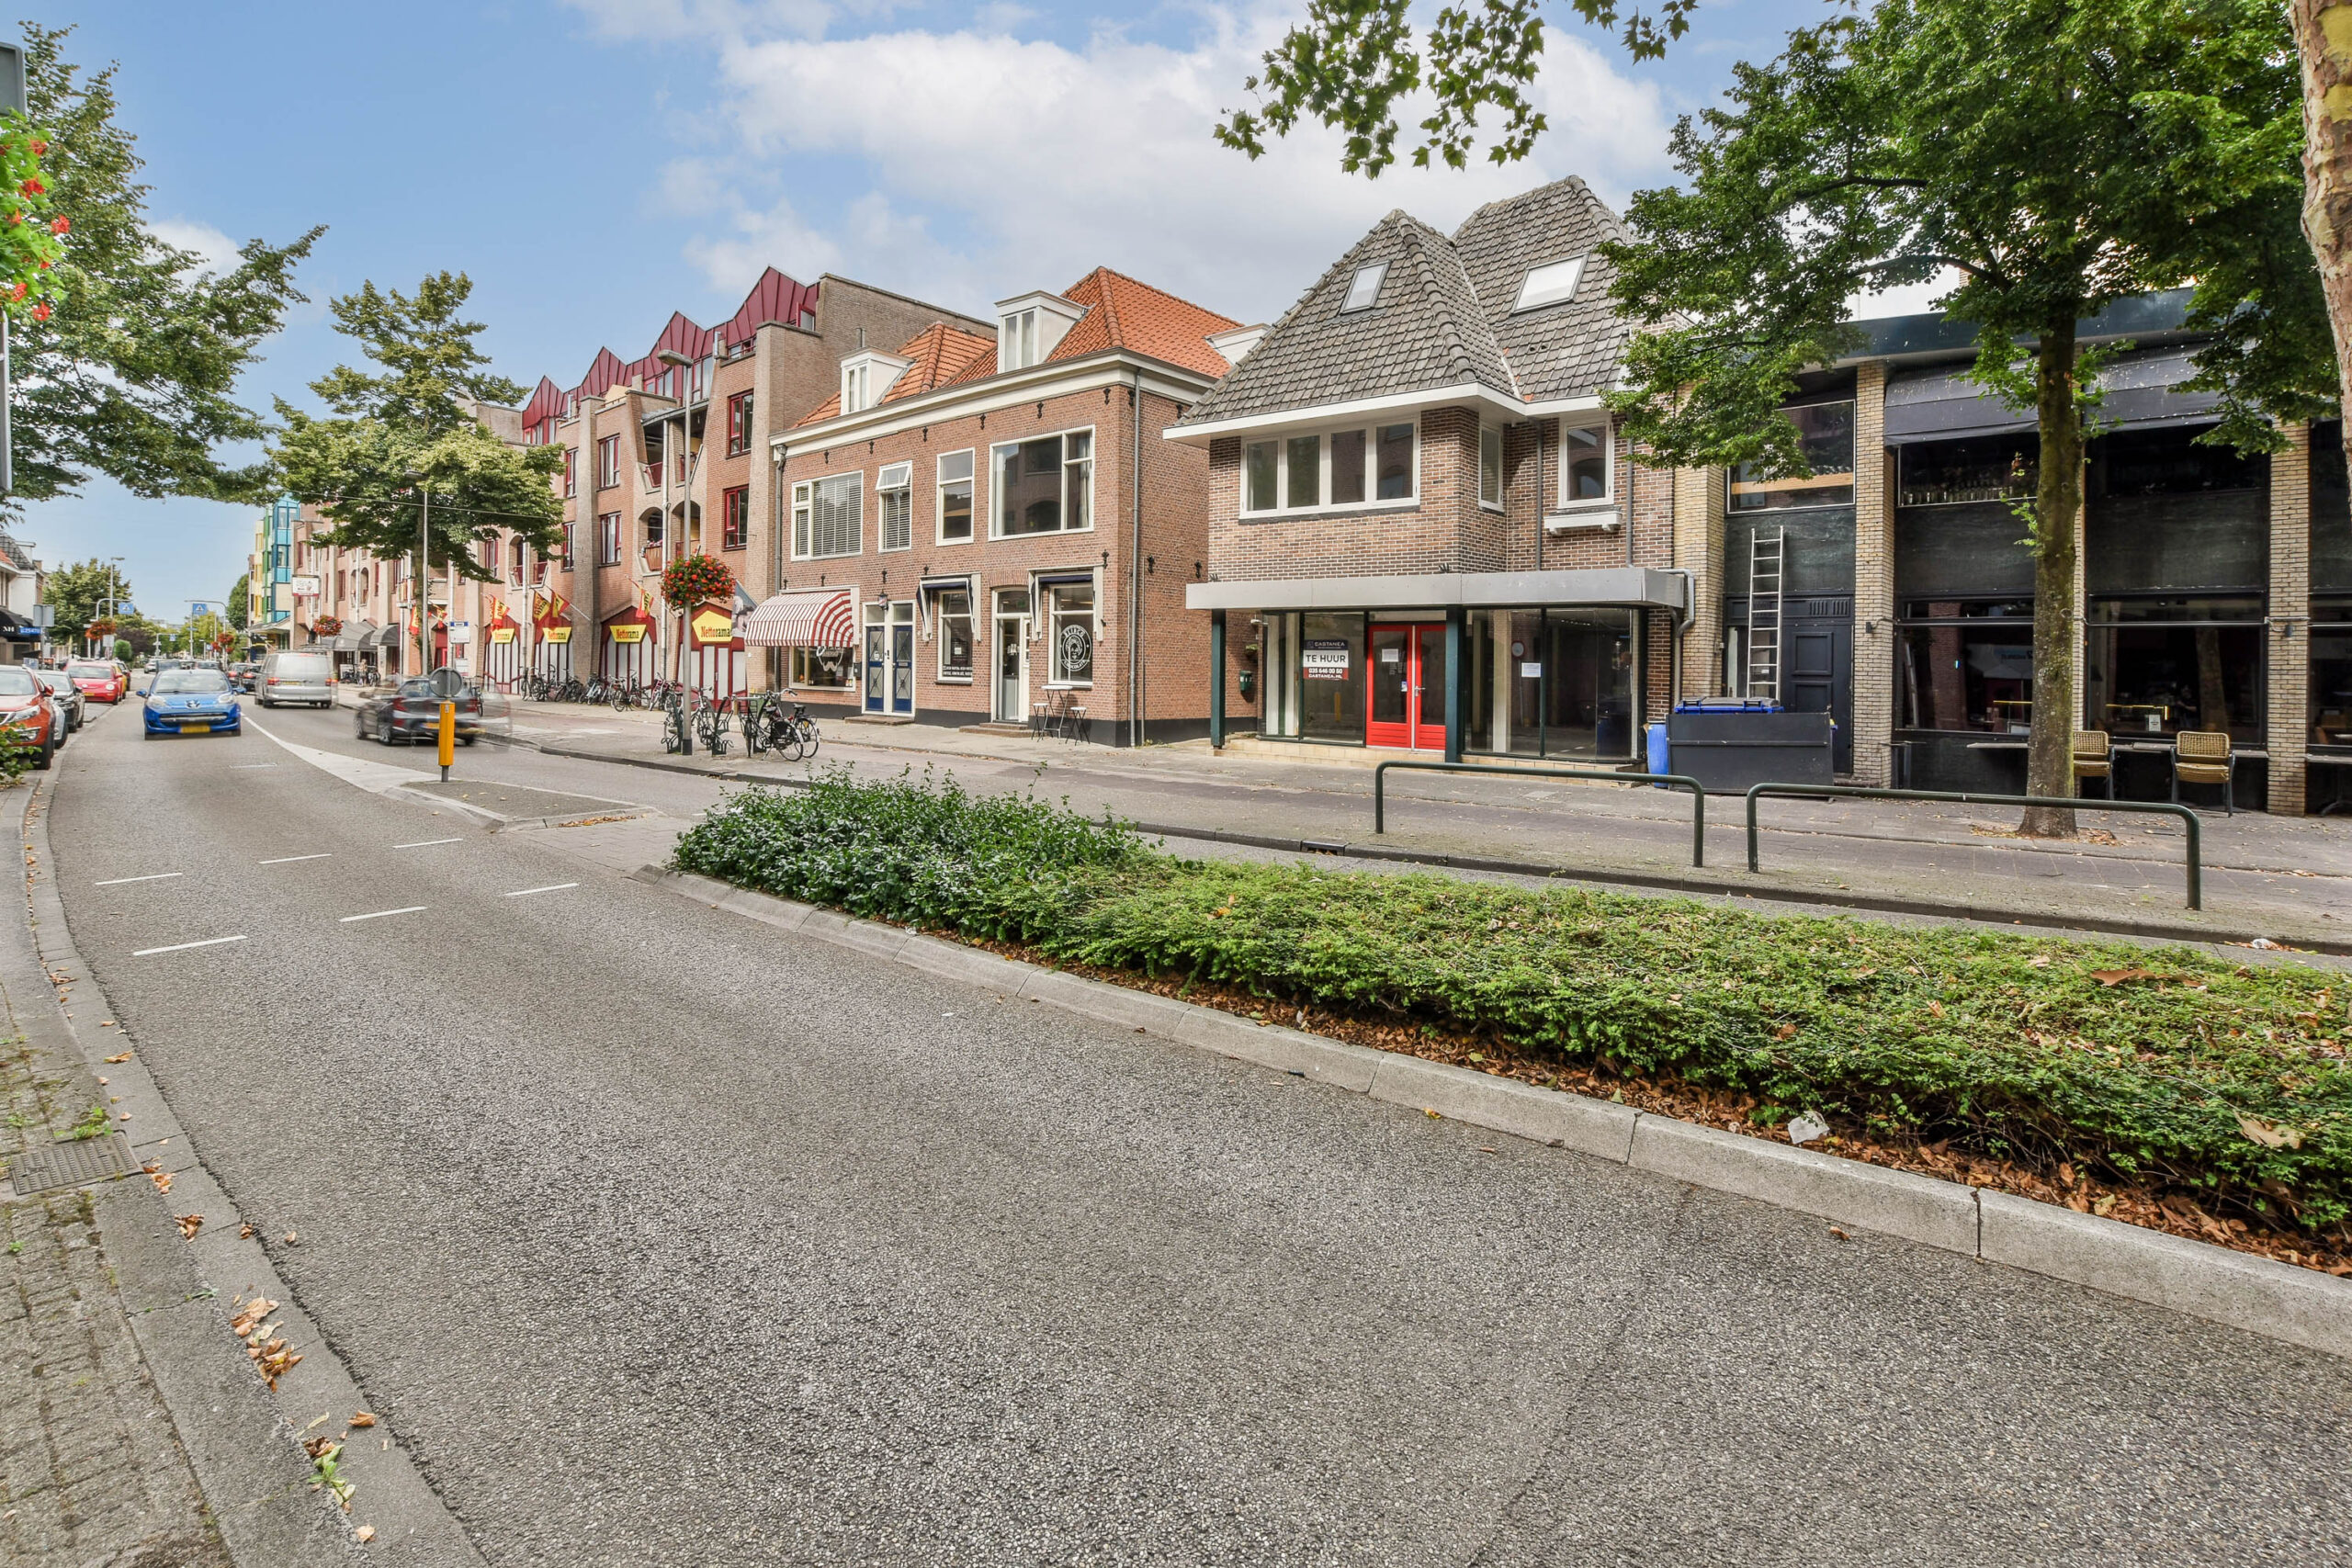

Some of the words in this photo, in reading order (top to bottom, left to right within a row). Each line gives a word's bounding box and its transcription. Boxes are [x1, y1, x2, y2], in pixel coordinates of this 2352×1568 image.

[616, 628, 639, 639] Nettorama
[701, 626, 731, 638] Nettorama
[1306, 654, 1317, 662] TE
[1319, 654, 1346, 662] HUUR
